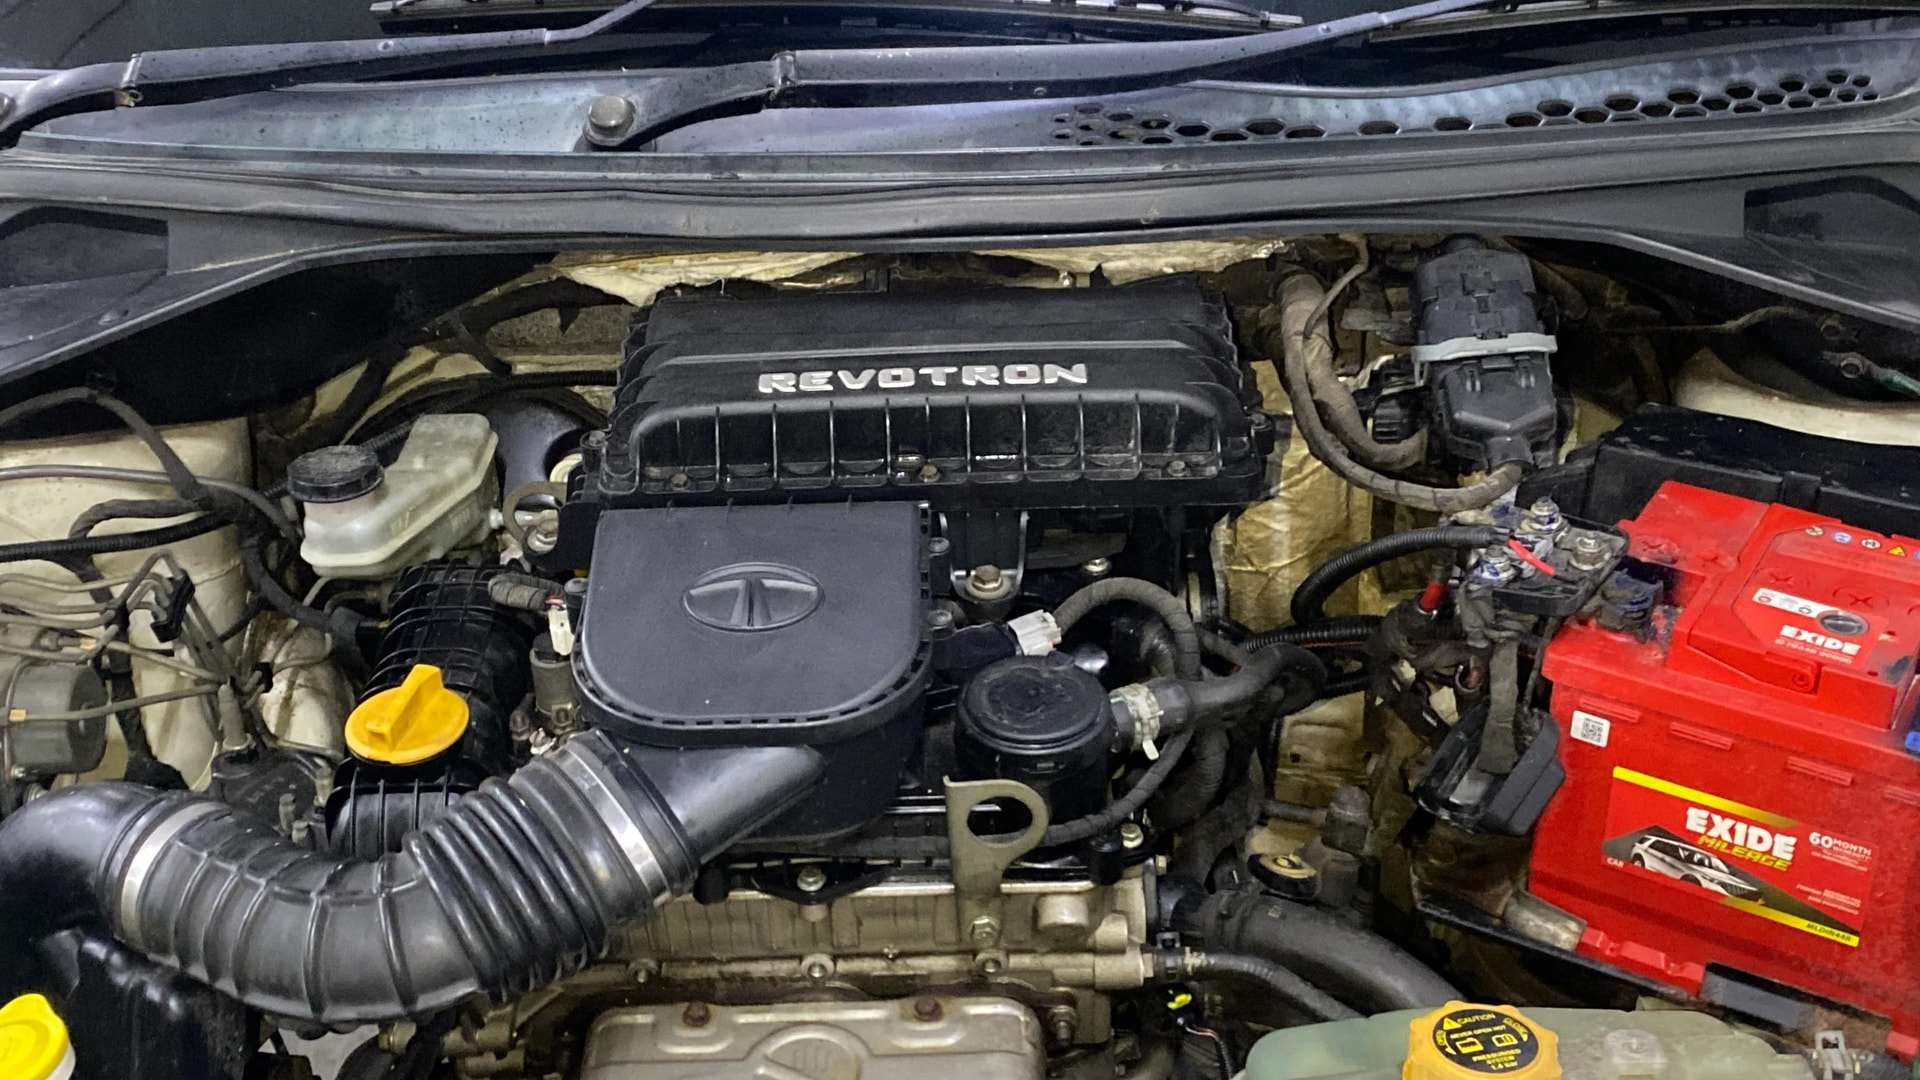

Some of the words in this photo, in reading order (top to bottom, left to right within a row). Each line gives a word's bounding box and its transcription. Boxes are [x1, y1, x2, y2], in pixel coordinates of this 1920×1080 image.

[758, 363, 1087, 393] REVOTRON
[1780, 625, 1862, 655] EXIDE
[1685, 806, 1798, 861] EXIDE
[1809, 832, 1833, 849] 60
[1833, 838, 1872, 856] MONTH
[1606, 857, 1624, 868] CAR
[1697, 835, 1792, 871] MILEAGE
[1457, 1013, 1495, 1024] CAUTION
